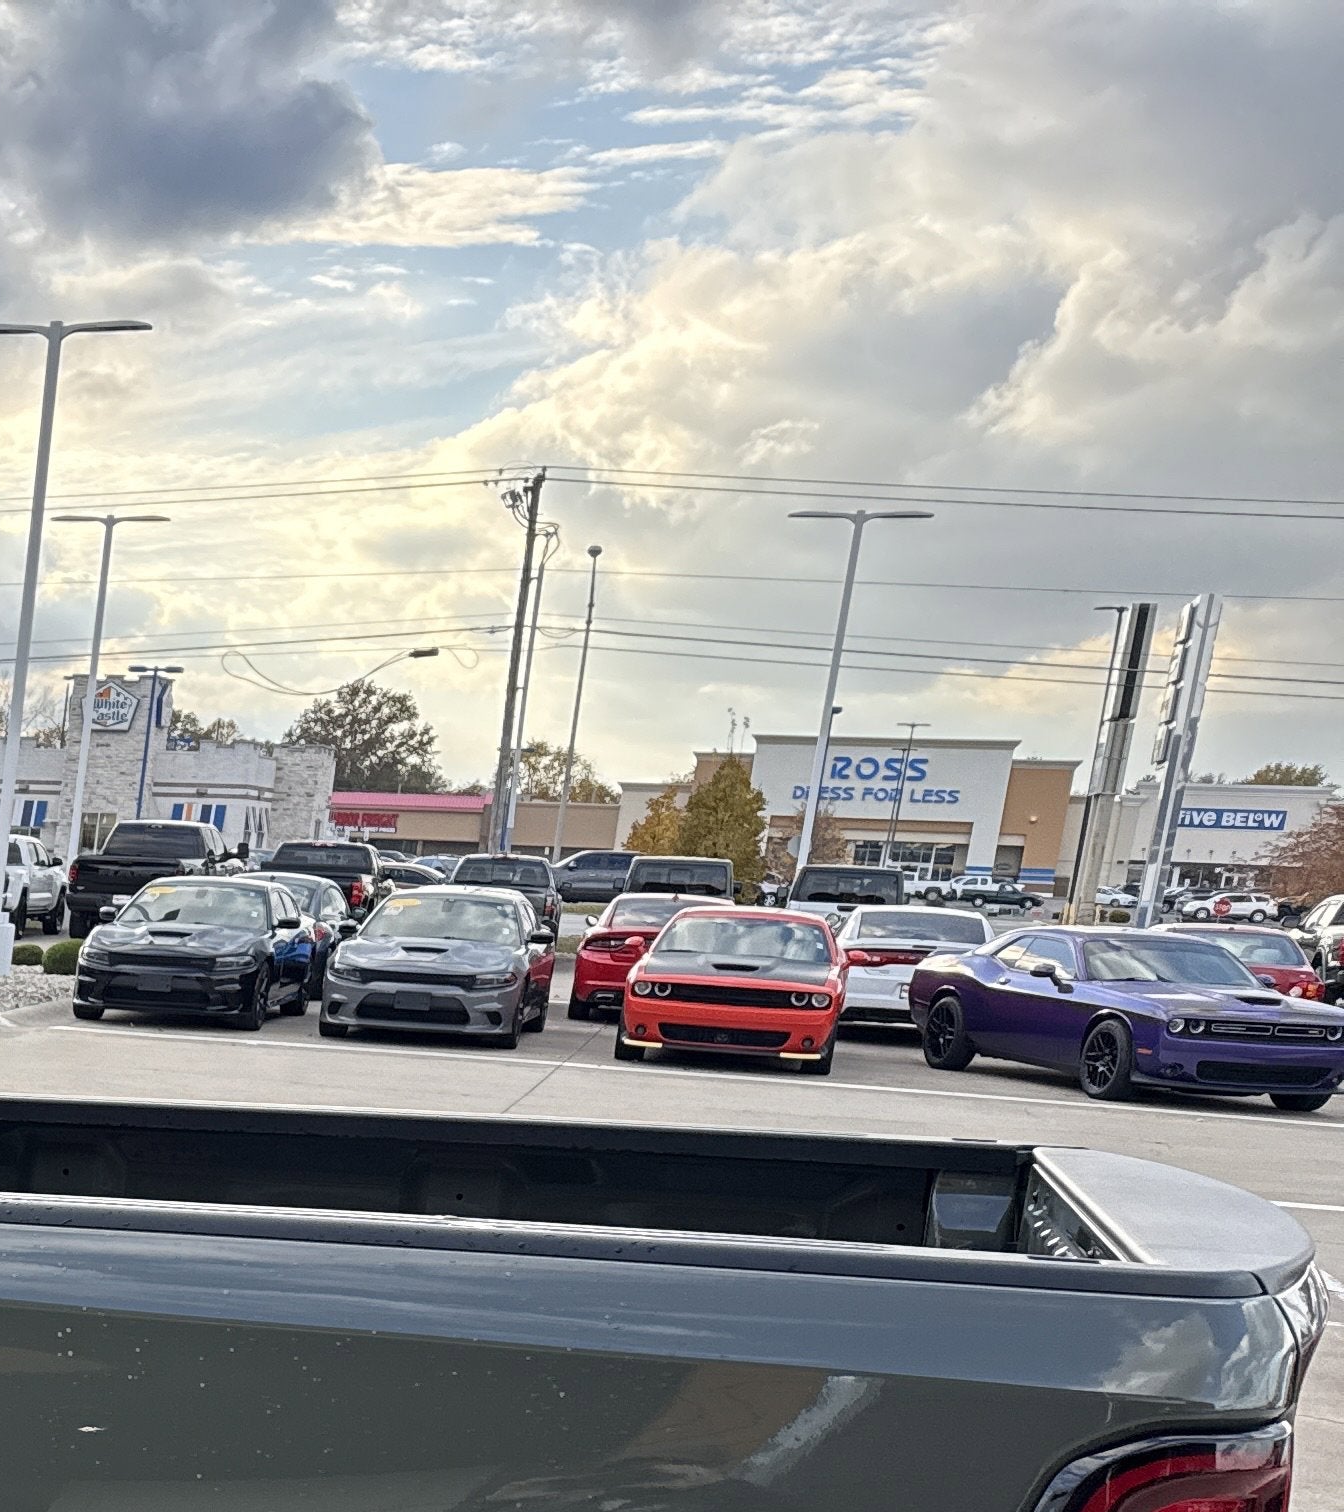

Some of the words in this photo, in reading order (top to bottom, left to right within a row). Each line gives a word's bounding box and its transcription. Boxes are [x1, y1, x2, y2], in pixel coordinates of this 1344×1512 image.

[92, 709, 129, 722] astle
[830, 756, 930, 782] ROSS
[909, 788, 961, 804] LESS
